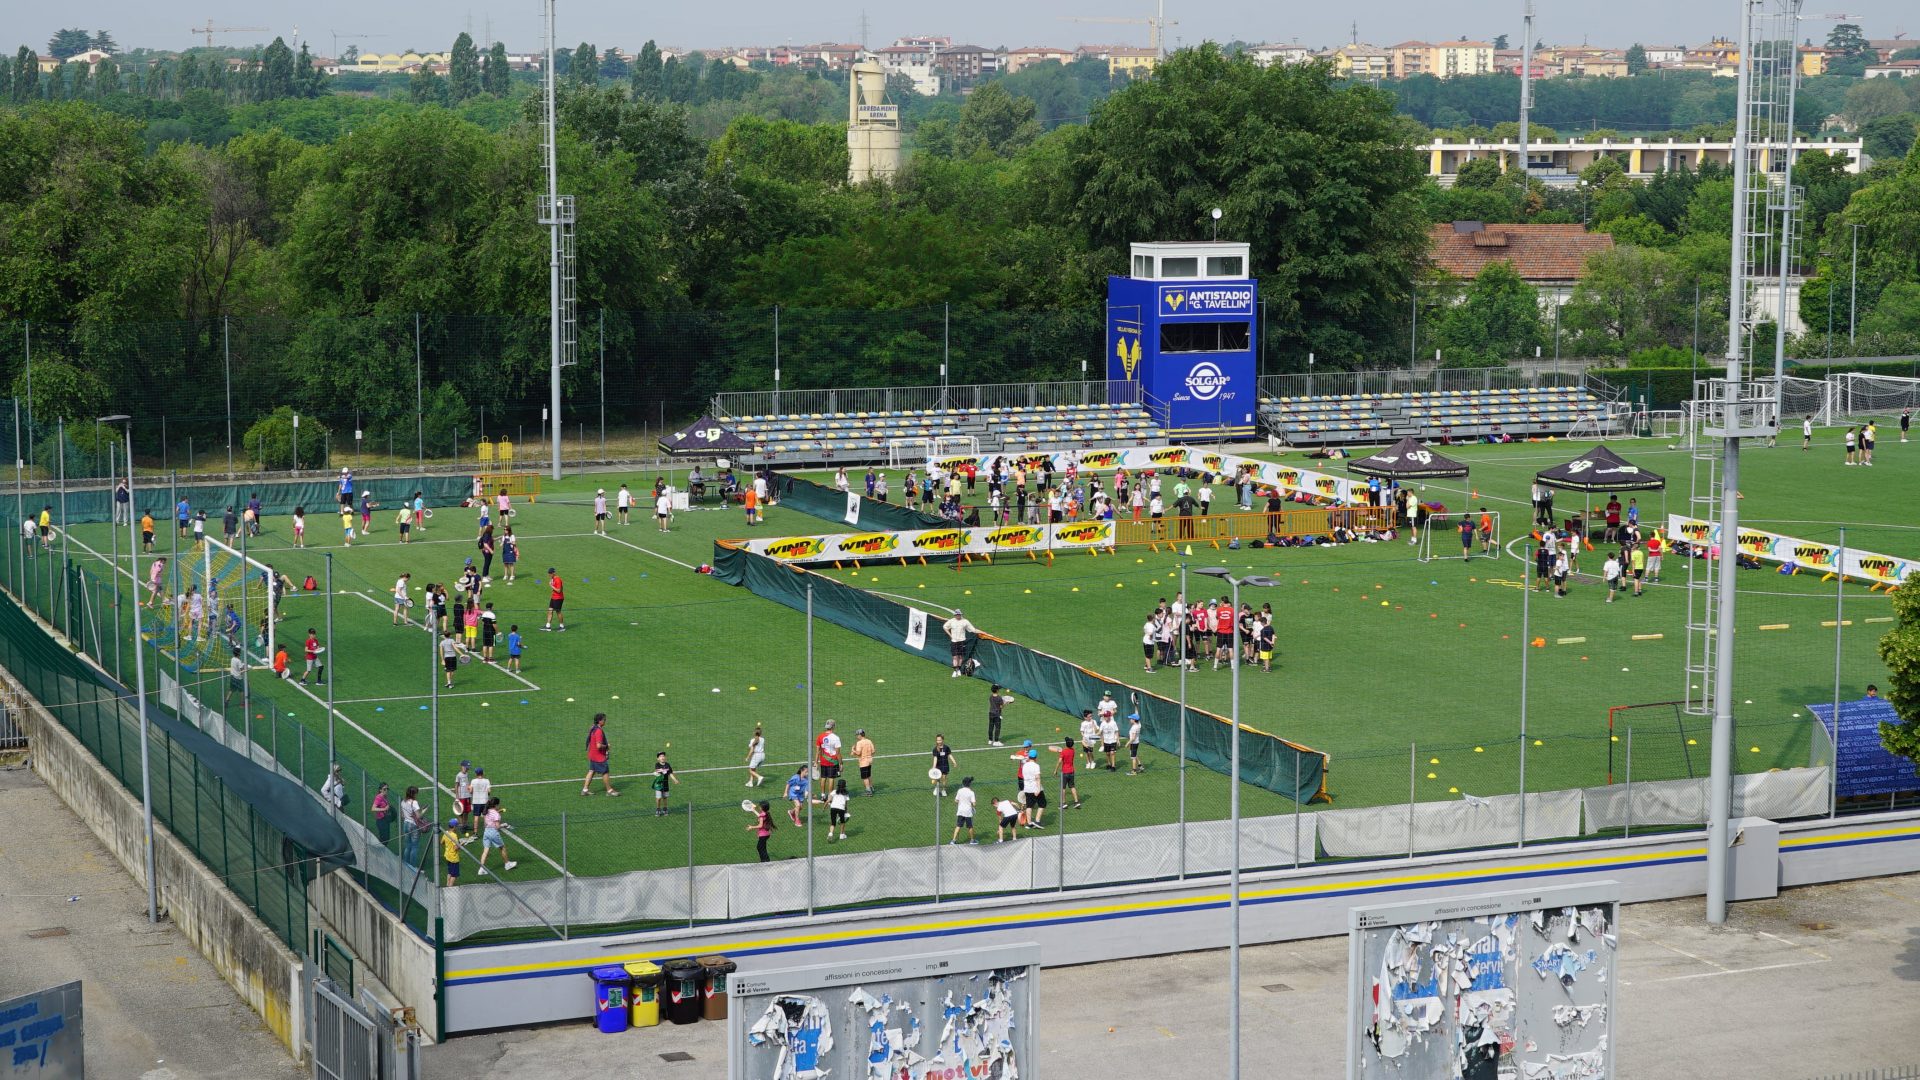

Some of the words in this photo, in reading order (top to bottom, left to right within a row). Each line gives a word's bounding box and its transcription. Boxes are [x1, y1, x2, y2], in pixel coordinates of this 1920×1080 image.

[1190, 291, 1250, 300] ANTISTADIO
[1173, 392, 1190, 401] Since
[1219, 392, 1236, 400] 1947
[1080, 452, 1117, 464] WIND
[1150, 449, 1186, 462] WIND
[1350, 488, 1370, 496] WIN
[912, 530, 958, 548] WIND
[984, 530, 1030, 544] WIND
[1056, 526, 1098, 540] WIND
[838, 536, 884, 551] WIND
[1738, 536, 1770, 544] WIND
[764, 540, 811, 556] WIND
[1794, 548, 1829, 556] WIND
[1860, 560, 1895, 569] WIND
[1434, 907, 1459, 915] affissioni
[1466, 902, 1501, 911] concessione
[1537, 960, 1561, 969] SMART
[825, 972, 852, 981] affissioni
[862, 967, 902, 977] concessione
